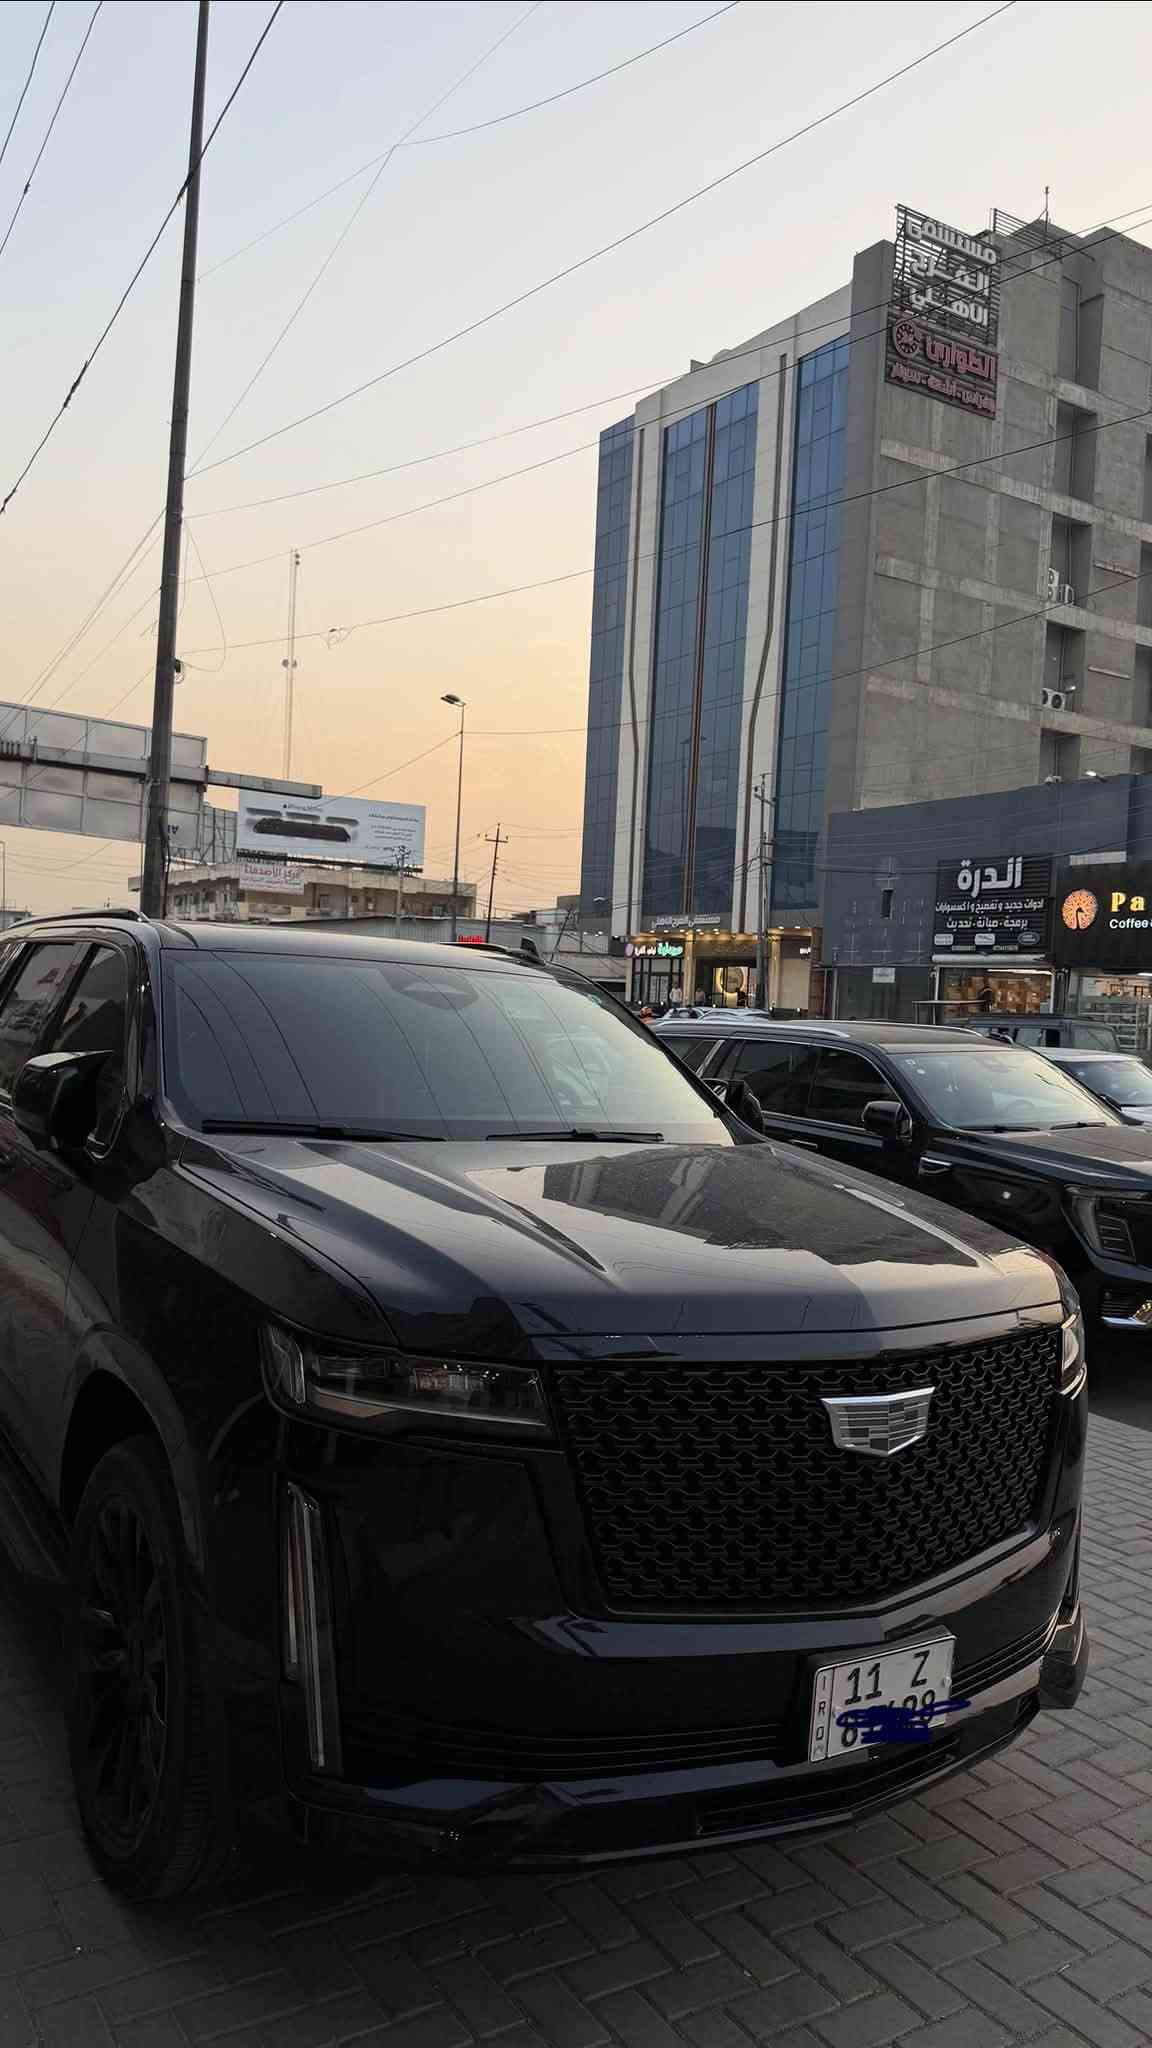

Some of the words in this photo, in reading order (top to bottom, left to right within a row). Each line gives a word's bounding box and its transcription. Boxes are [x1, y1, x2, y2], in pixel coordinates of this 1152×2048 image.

[905, 217, 997, 266] مستشفى
[957, 856, 1023, 898] الدرة
[976, 916, 998, 931] صيانة
[1004, 916, 1029, 931] برمجة
[1109, 918, 1149, 929] Coffee
[844, 1662, 883, 1706] 11
[910, 1649, 931, 1689] Z
